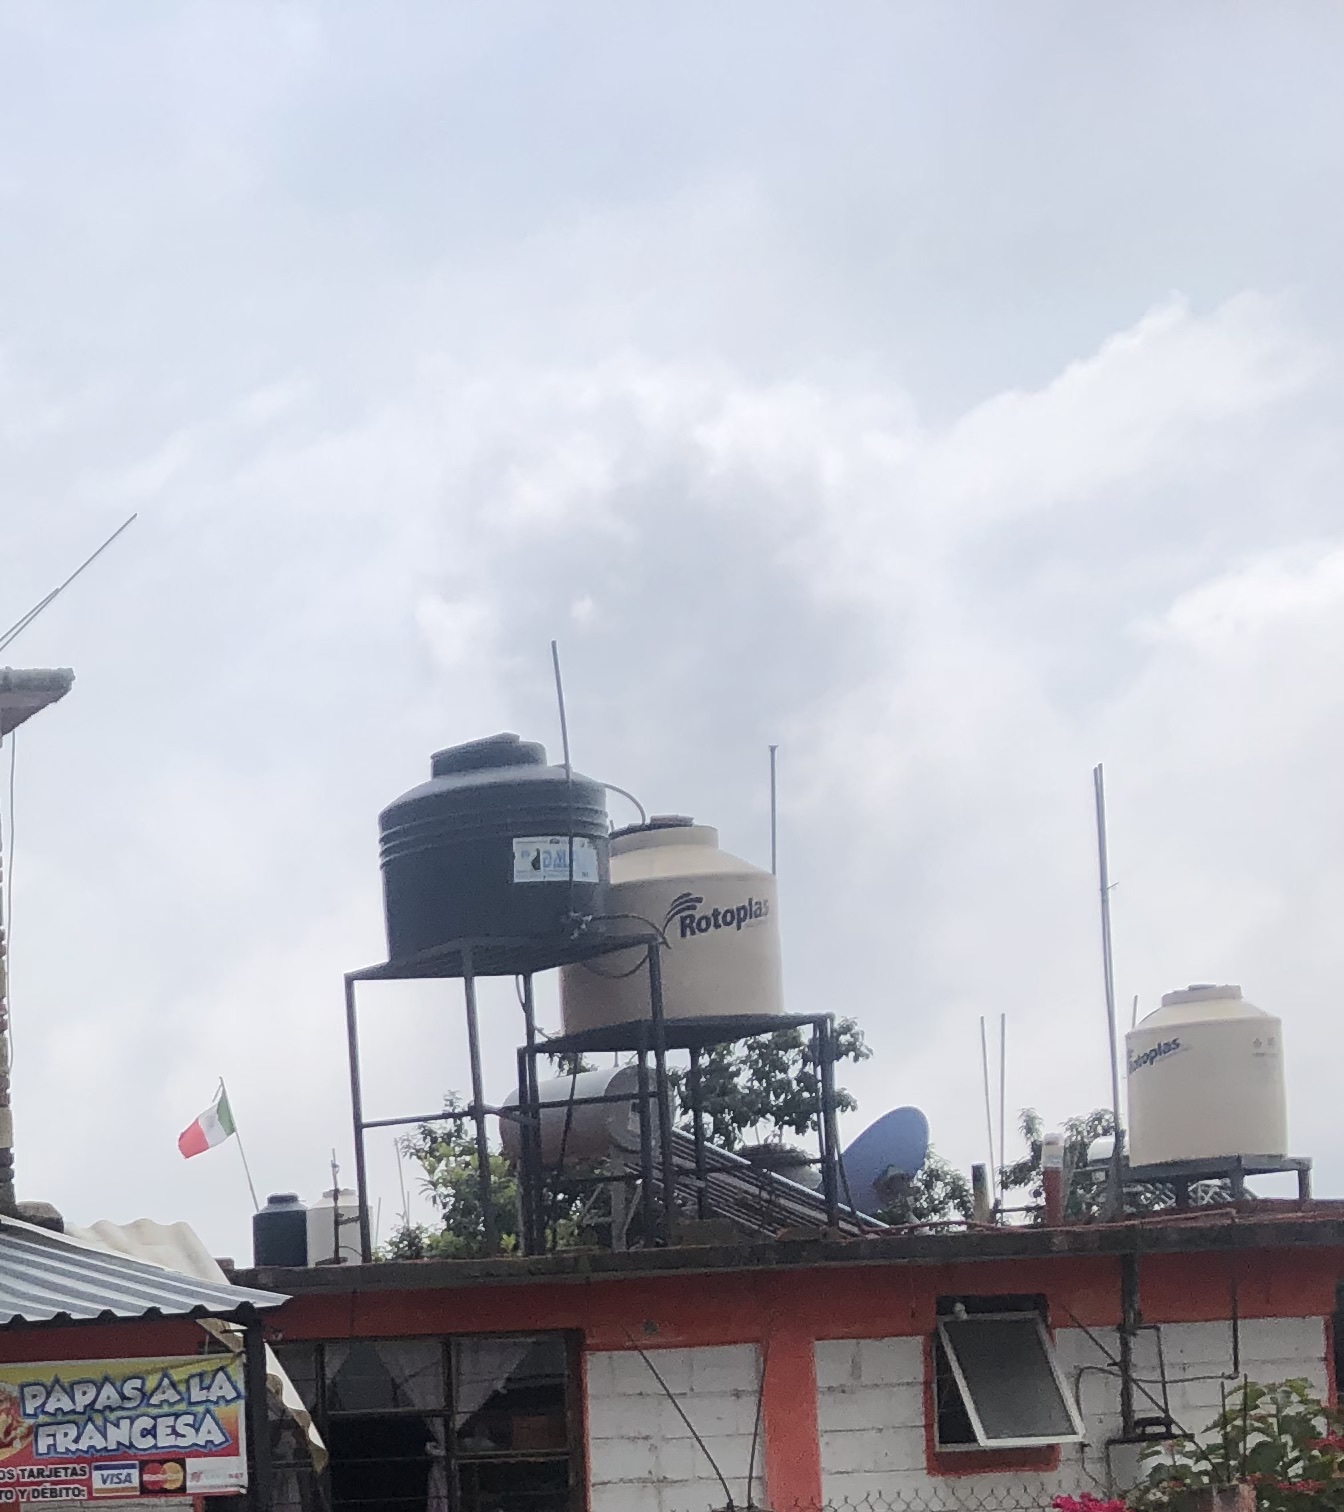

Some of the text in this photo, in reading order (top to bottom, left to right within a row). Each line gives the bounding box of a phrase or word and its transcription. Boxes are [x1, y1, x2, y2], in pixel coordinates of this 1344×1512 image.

[21, 1368, 238, 1416] PAPAS A LA
[35, 1410, 228, 1455] FRANCESA
[19, 1465, 88, 1480] TARJETAS
[100, 1471, 133, 1486] VISA
[17, 1488, 28, 1500] Y
